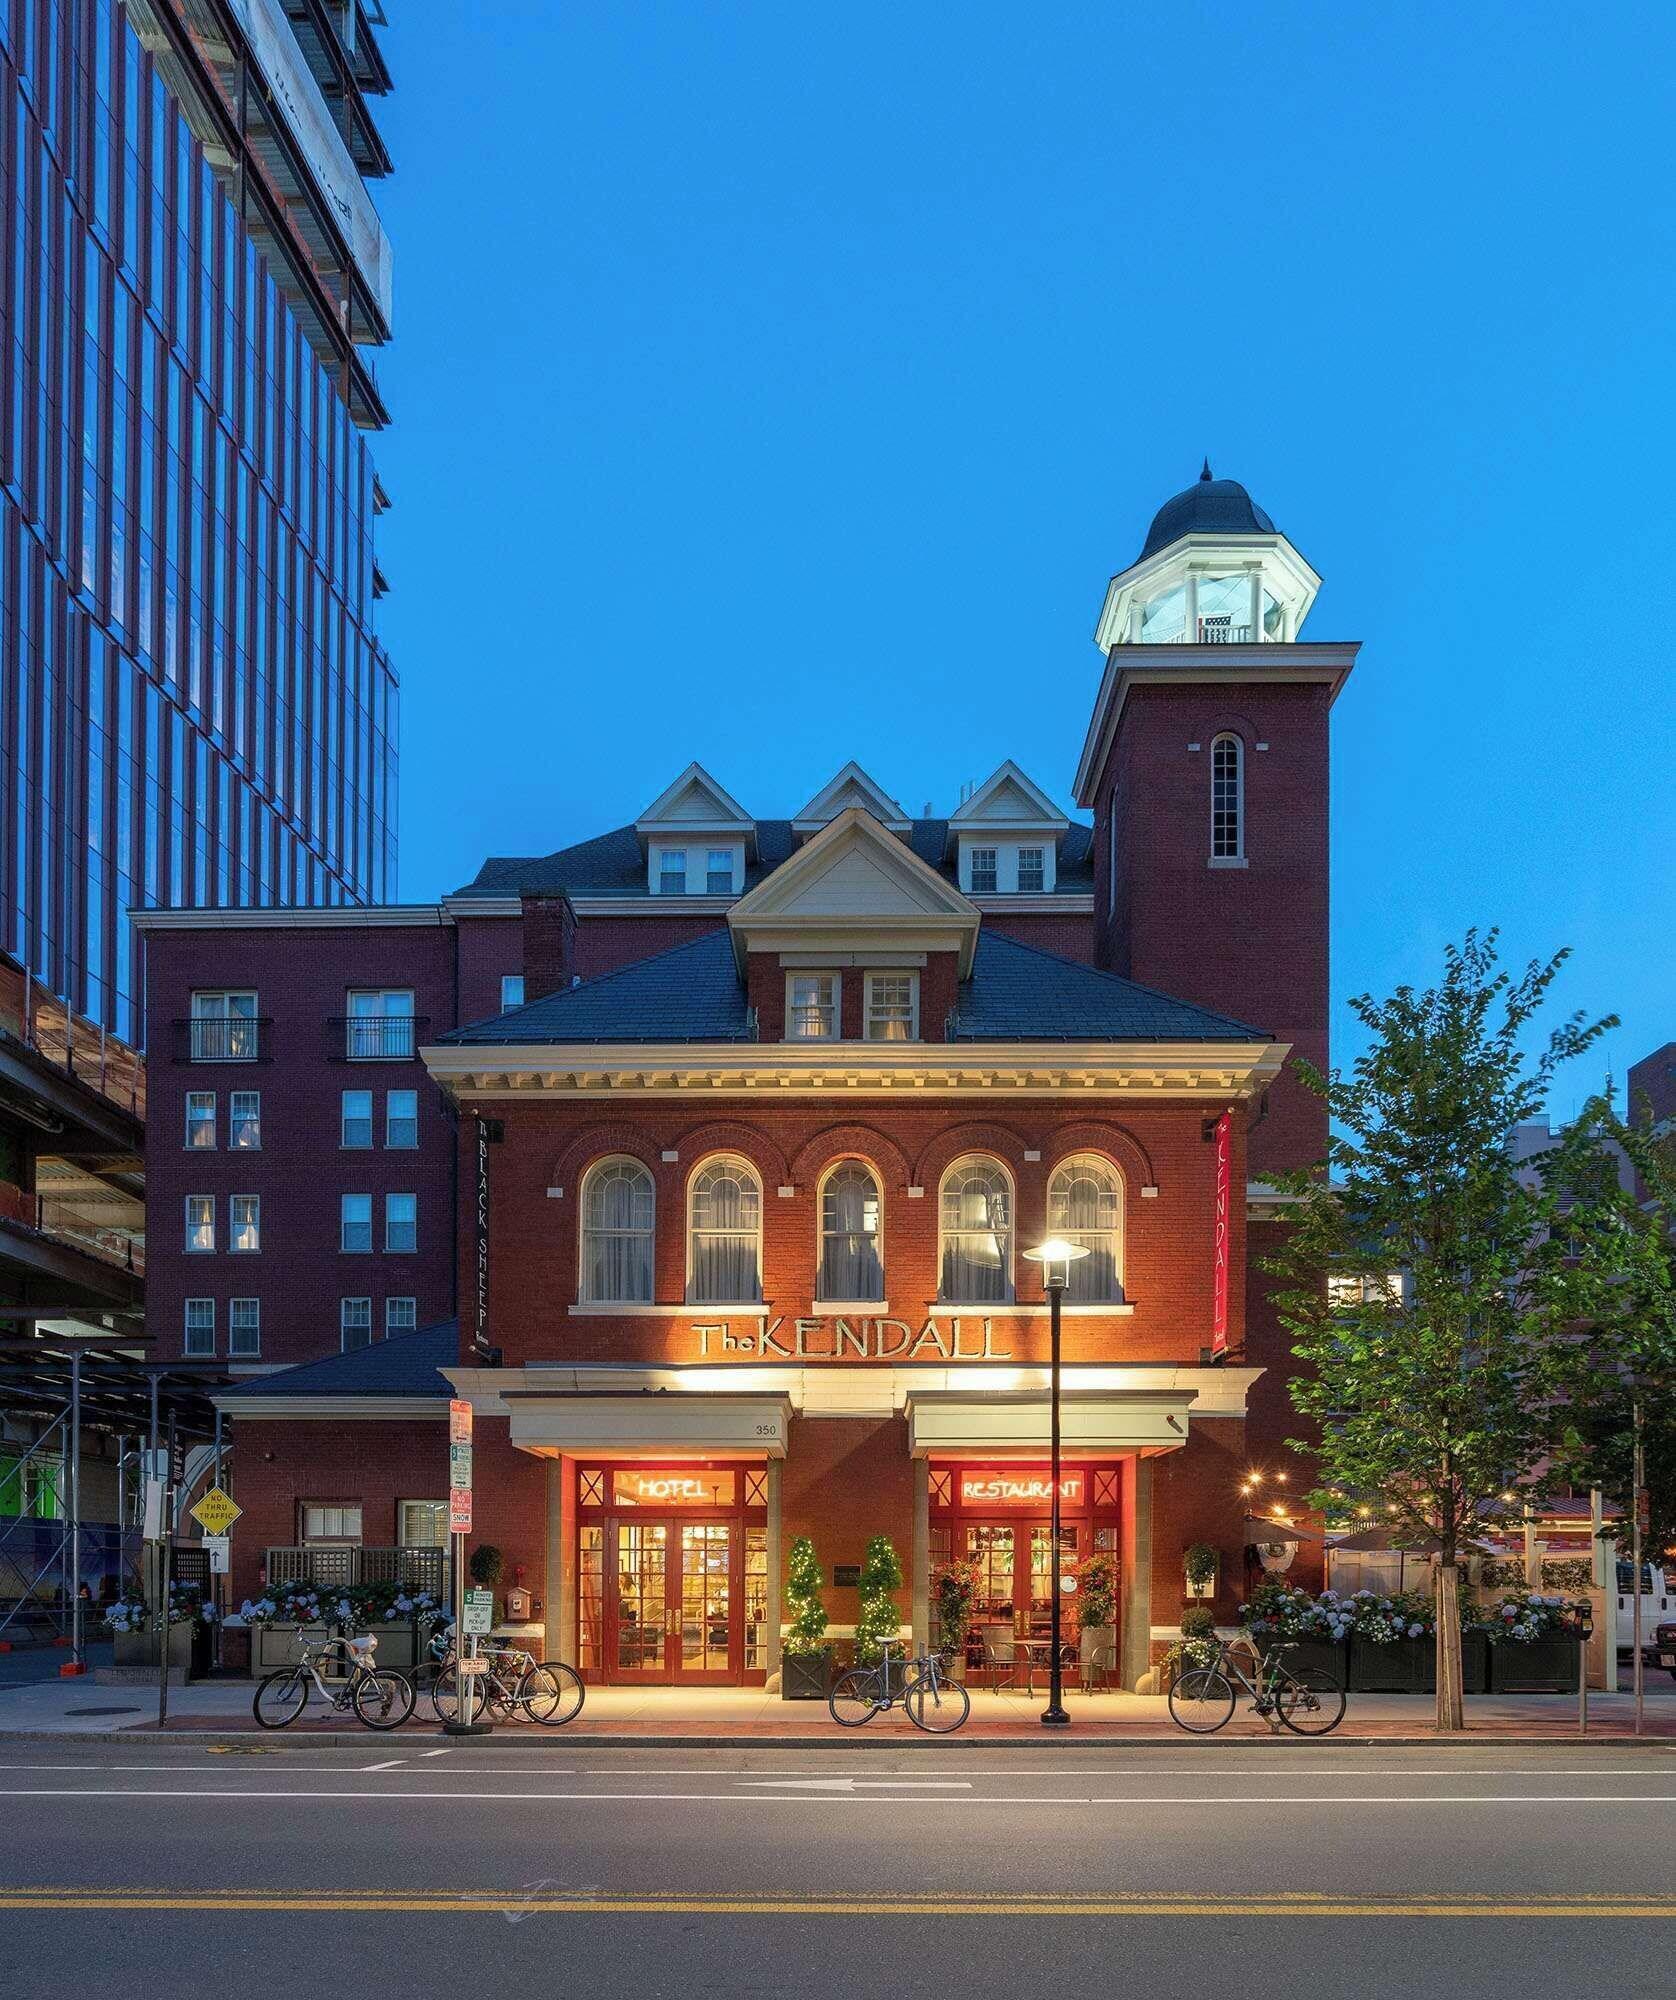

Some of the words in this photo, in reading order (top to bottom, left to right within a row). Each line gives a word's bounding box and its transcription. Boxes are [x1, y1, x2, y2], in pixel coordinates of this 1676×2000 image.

[479, 1139, 488, 1229] BLACK
[1215, 1139, 1226, 1323] KENDALL
[479, 1238, 488, 1327] SHEEP
[691, 1323, 755, 1356] The
[757, 1315, 1012, 1359] KENDALL
[756, 1425, 777, 1435] 350
[637, 1479, 709, 1498] HOTEL
[963, 1480, 1081, 1498] RESTAURANT
[200, 1512, 234, 1520] TRAFFIC
[453, 1513, 469, 1521] SNOW
[466, 1593, 472, 1602] 5
